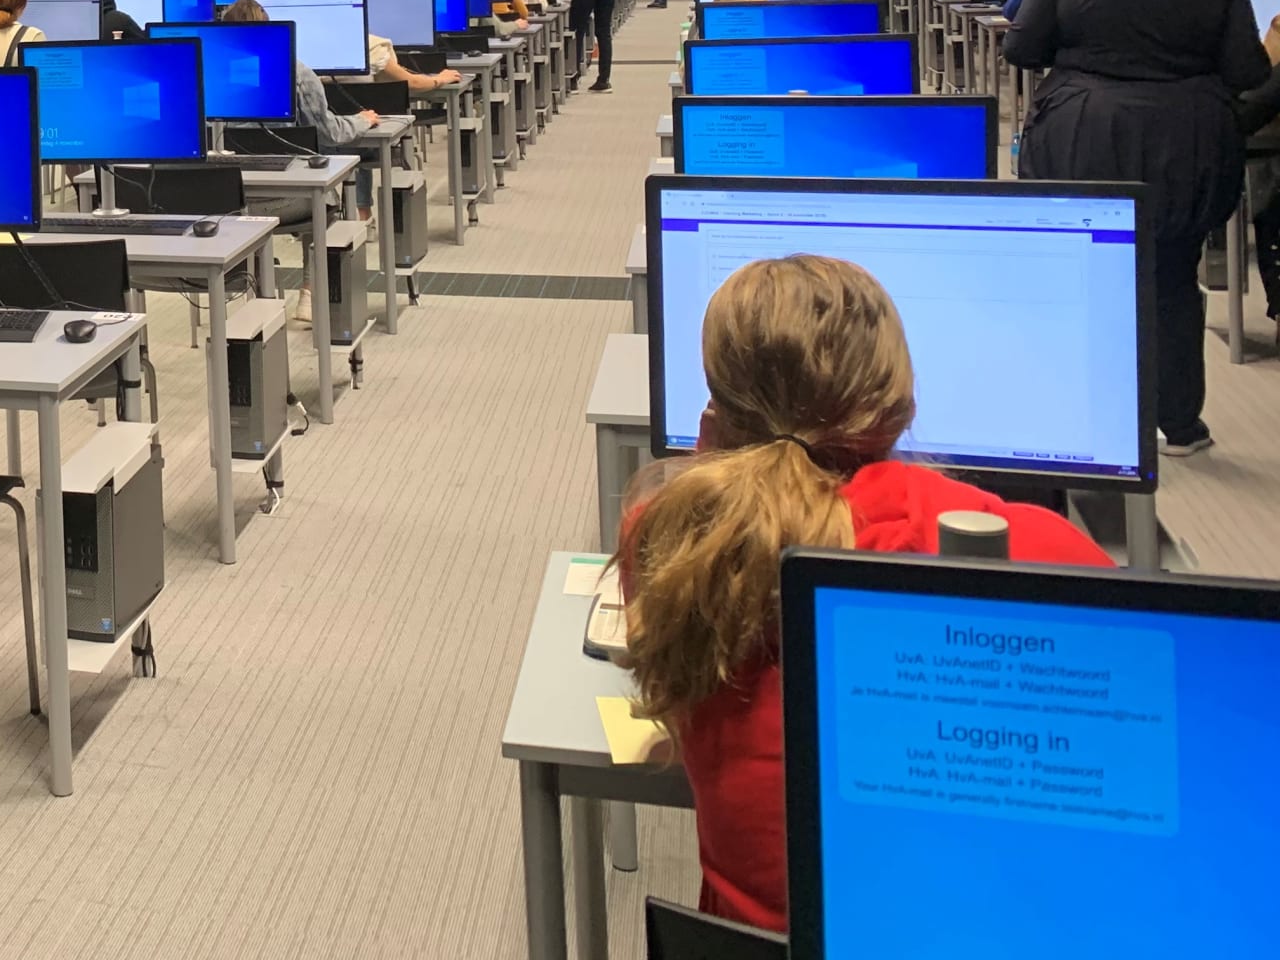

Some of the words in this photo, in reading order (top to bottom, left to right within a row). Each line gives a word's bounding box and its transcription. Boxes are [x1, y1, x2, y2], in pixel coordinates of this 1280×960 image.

[945, 623, 1055, 656] Inloggen
[937, 719, 1038, 754] Logging
[1048, 730, 1070, 753] in
[1032, 760, 1104, 780] Password
[1030, 778, 1103, 798] Password
